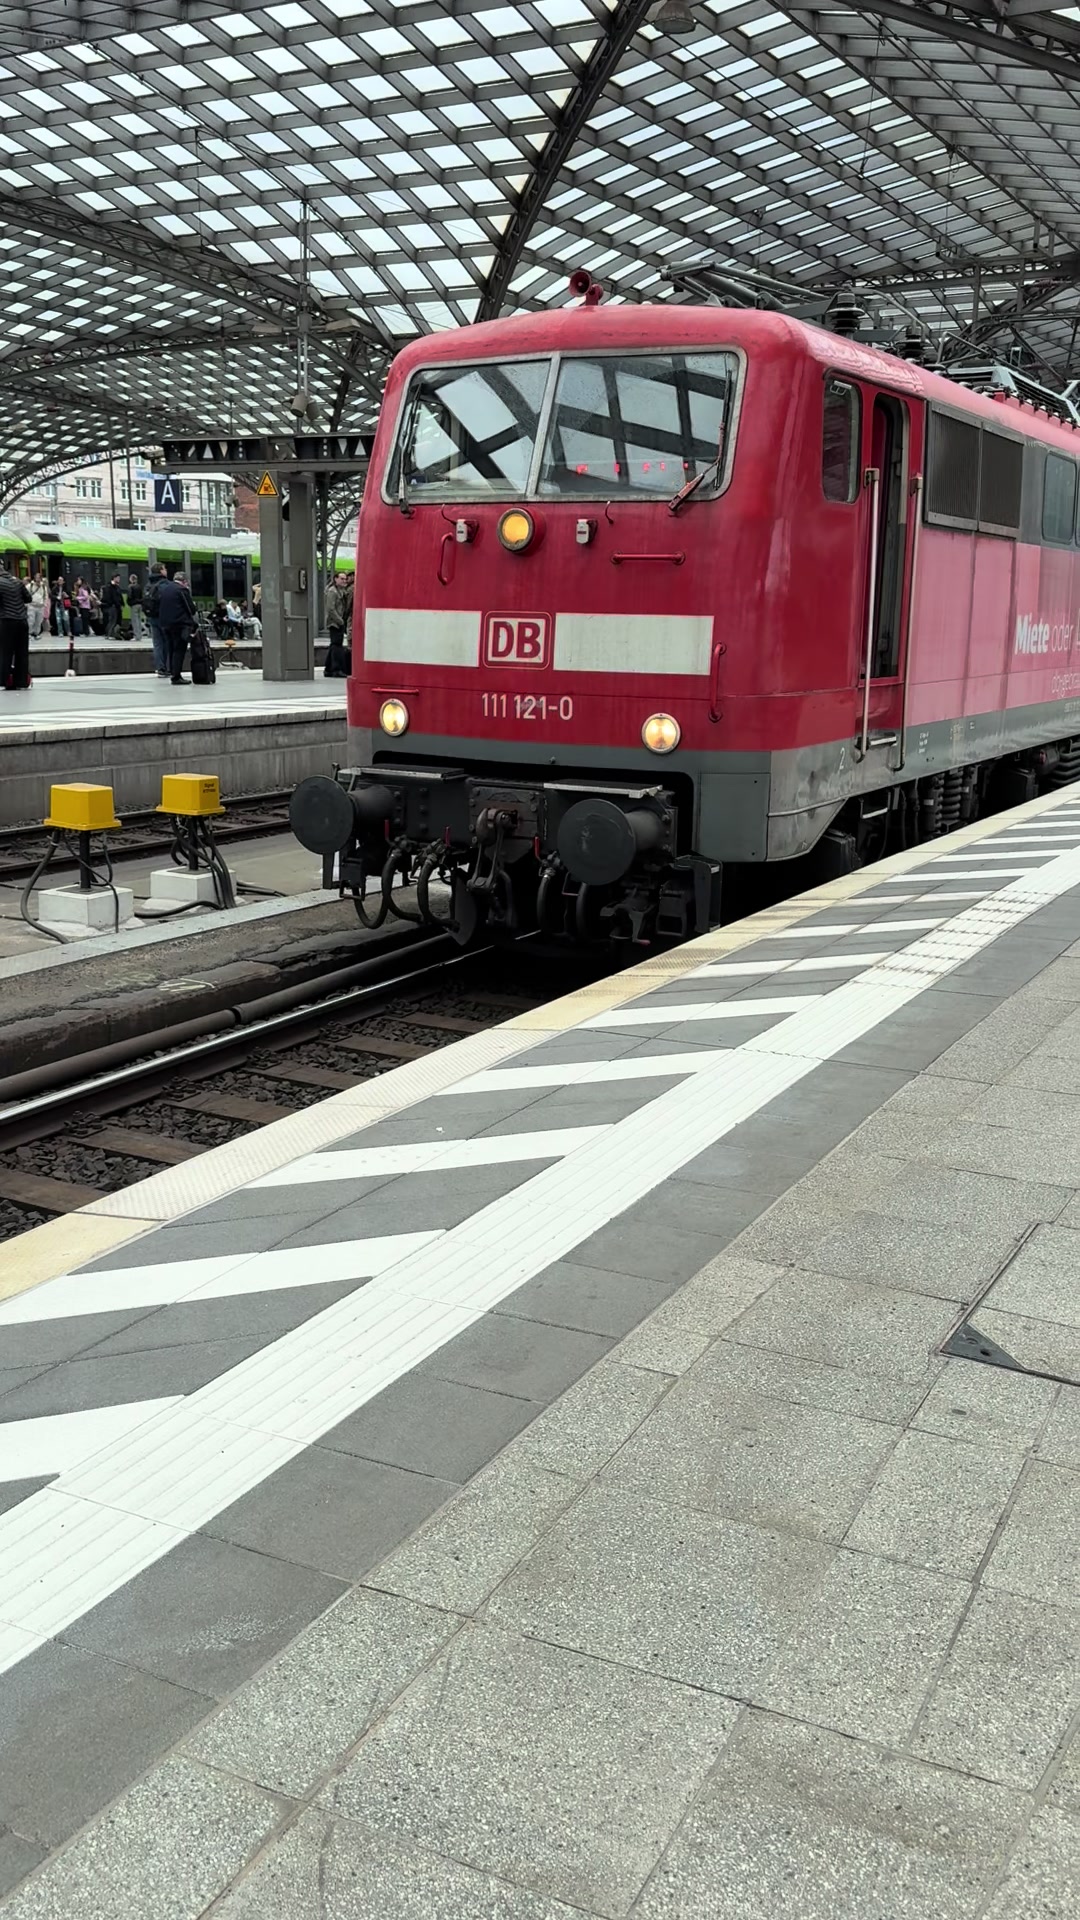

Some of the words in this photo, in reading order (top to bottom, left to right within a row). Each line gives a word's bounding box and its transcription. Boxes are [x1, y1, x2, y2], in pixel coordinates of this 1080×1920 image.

[161, 480, 176, 505] A
[491, 620, 541, 659] DB
[1014, 613, 1050, 655] Miete
[1051, 613, 1074, 652] oder
[482, 693, 507, 718] 111
[514, 694, 573, 720] 121-0
